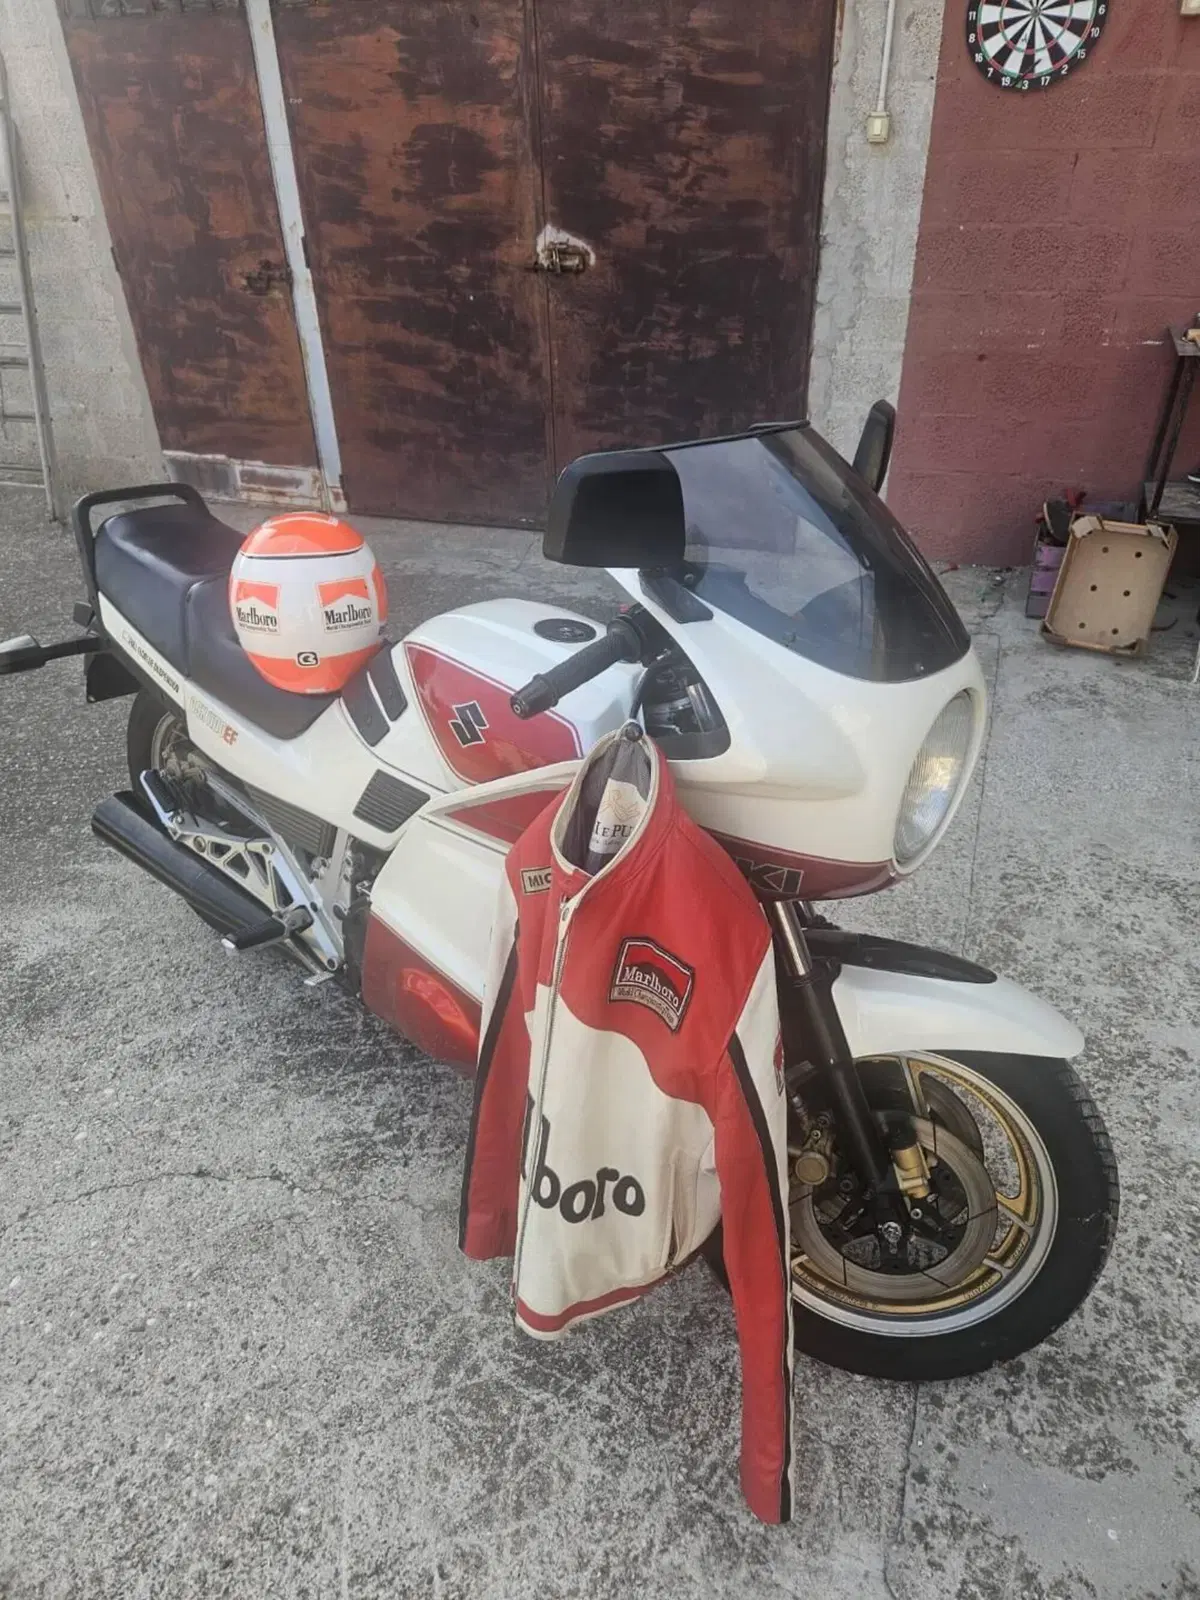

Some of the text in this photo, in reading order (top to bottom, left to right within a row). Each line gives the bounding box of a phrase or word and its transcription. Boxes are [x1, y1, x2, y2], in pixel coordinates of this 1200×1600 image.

[1098, 4, 1106, 15] 6
[968, 11, 977, 21] 11
[1090, 27, 1100, 38] 10
[968, 33, 976, 43] 8
[974, 53, 983, 63] 16
[1077, 49, 1086, 59] 15
[987, 67, 994, 77] 7
[1060, 64, 1069, 75] 2
[1001, 76, 1011, 86] 19
[1021, 80, 1029, 90] 3
[1040, 76, 1051, 86] 17
[621, 966, 679, 1007] Marlboro
